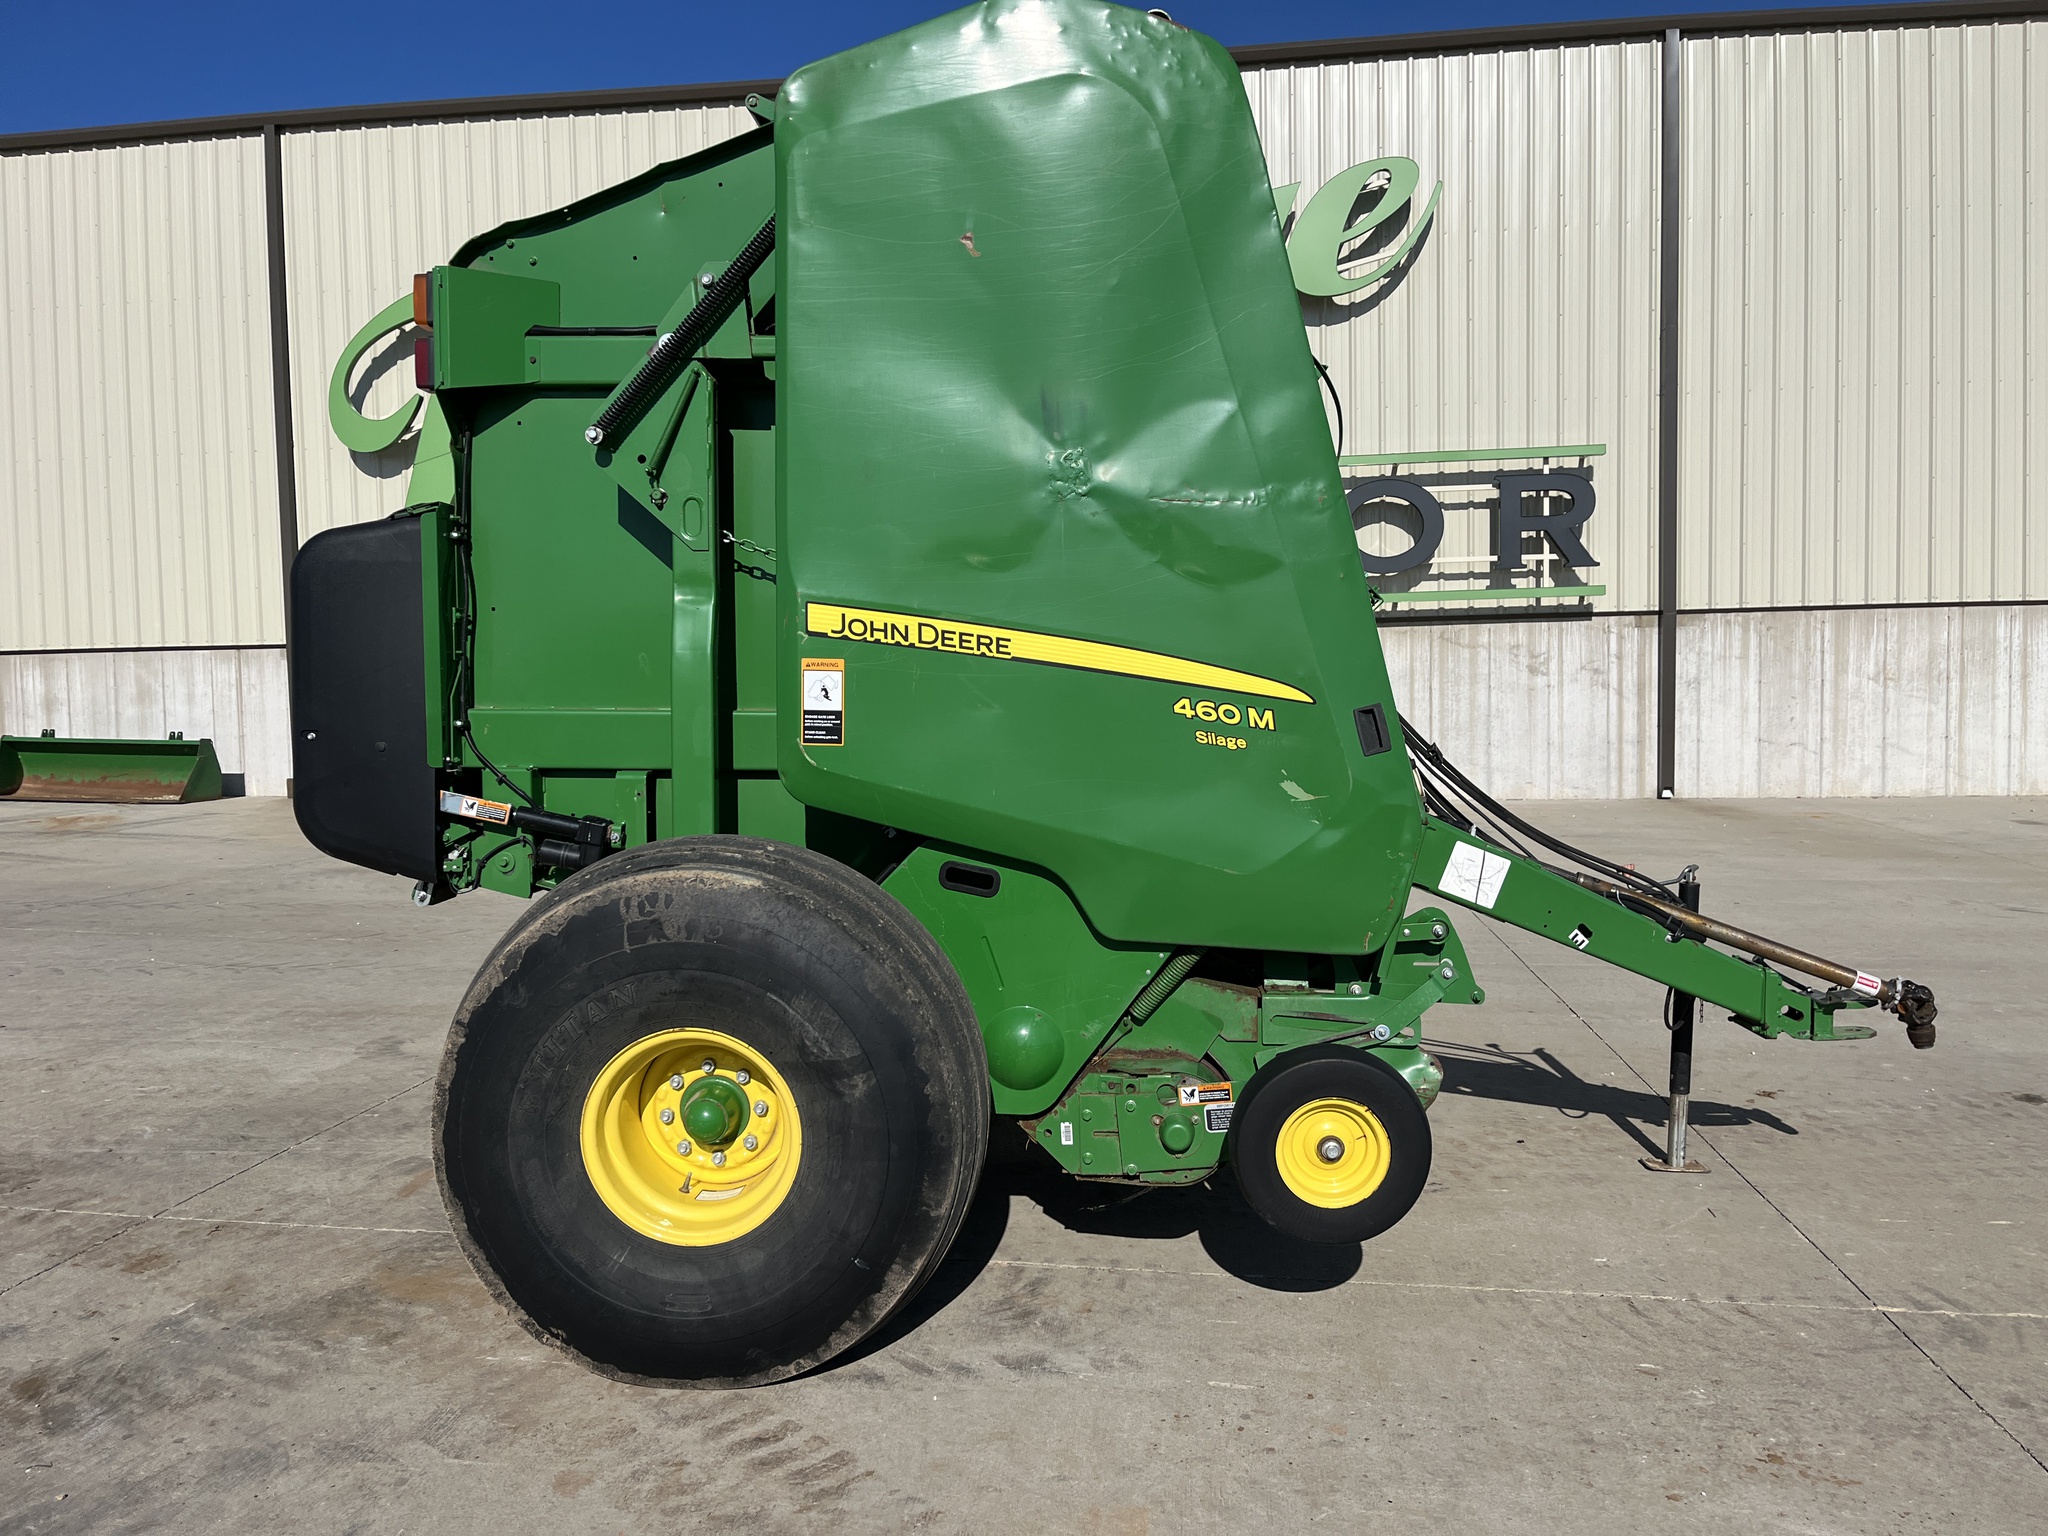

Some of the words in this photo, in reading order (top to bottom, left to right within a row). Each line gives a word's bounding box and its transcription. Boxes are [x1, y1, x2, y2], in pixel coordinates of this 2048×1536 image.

[831, 612, 909, 643] JOHN
[917, 622, 1012, 656] DEERE
[1173, 696, 1243, 726] 460
[1246, 705, 1277, 732] M
[1194, 730, 1248, 751] Silage
[526, 982, 637, 1083] TITAN
